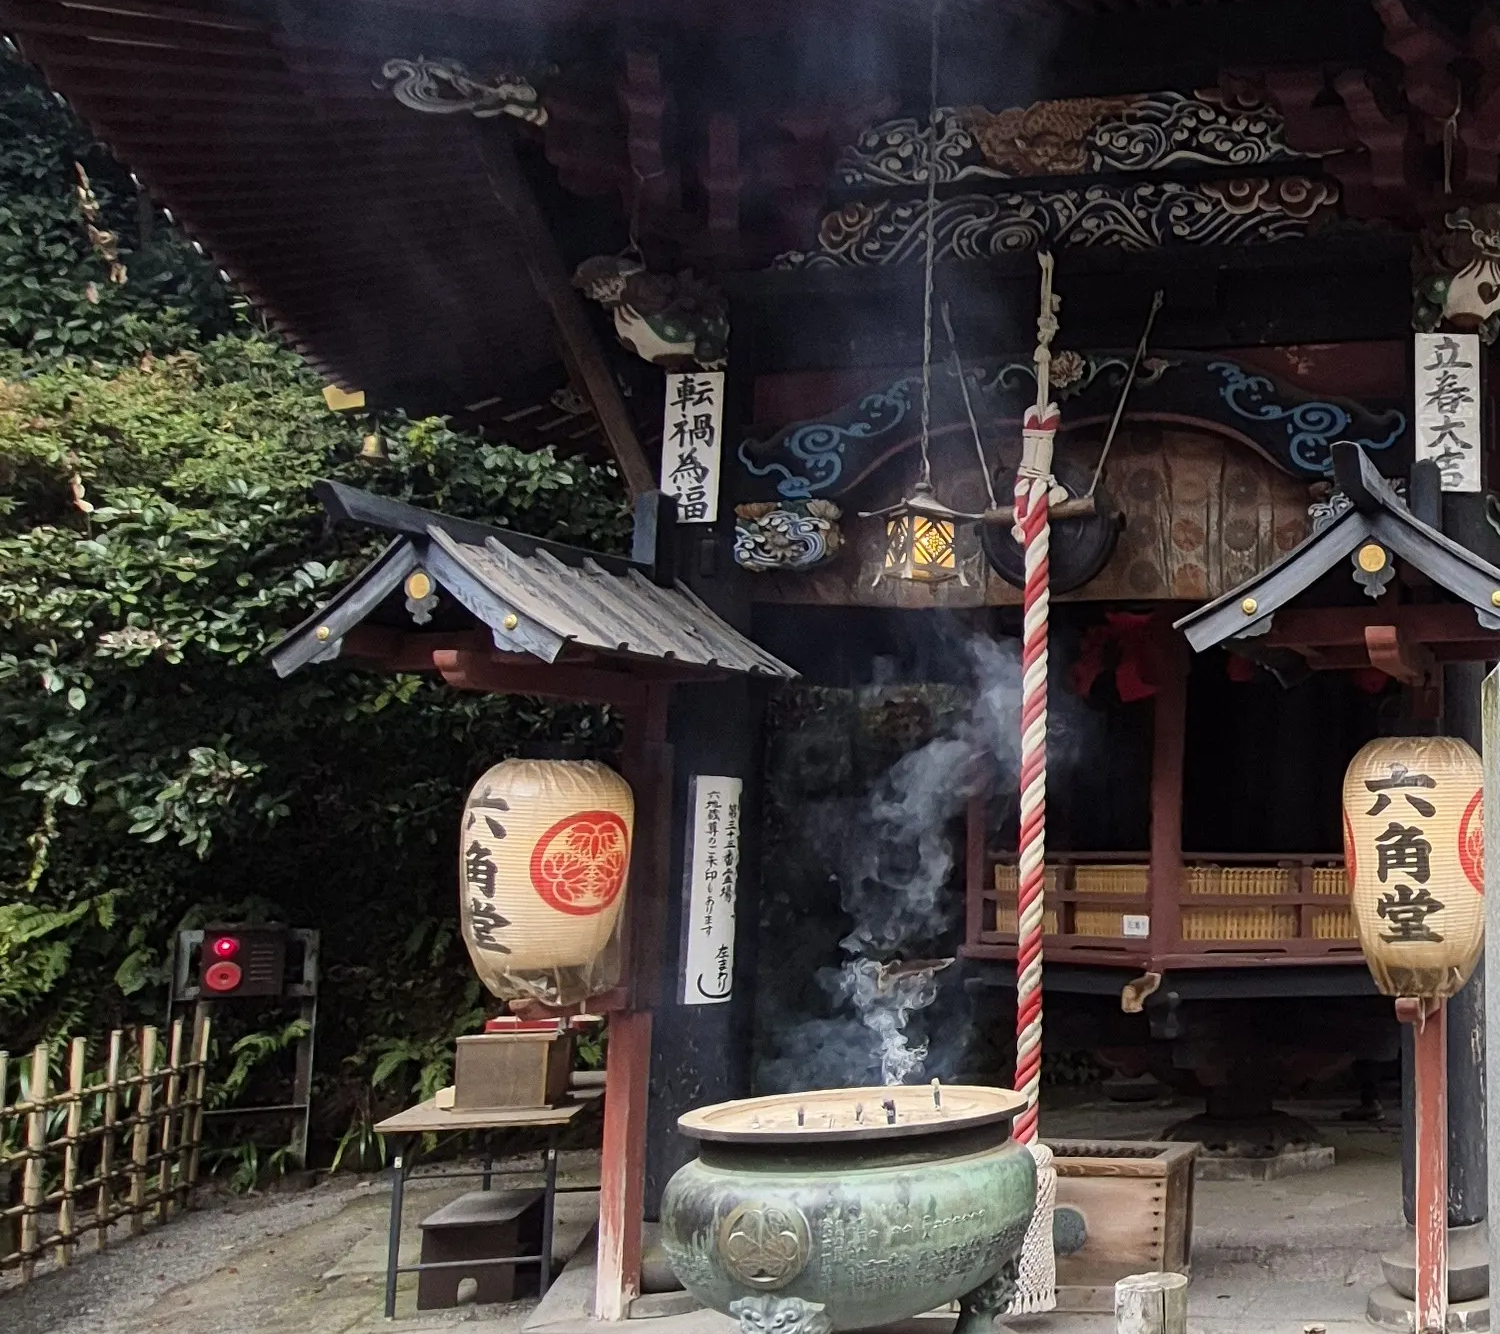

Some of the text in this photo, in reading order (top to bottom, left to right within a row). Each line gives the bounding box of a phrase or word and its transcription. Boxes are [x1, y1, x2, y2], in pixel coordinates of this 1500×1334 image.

[668, 375, 715, 521] 転禍為福
[1423, 336, 1475, 488] 立春大吉
[466, 785, 513, 955] 六角堂
[1364, 762, 1446, 944] 六角堂
